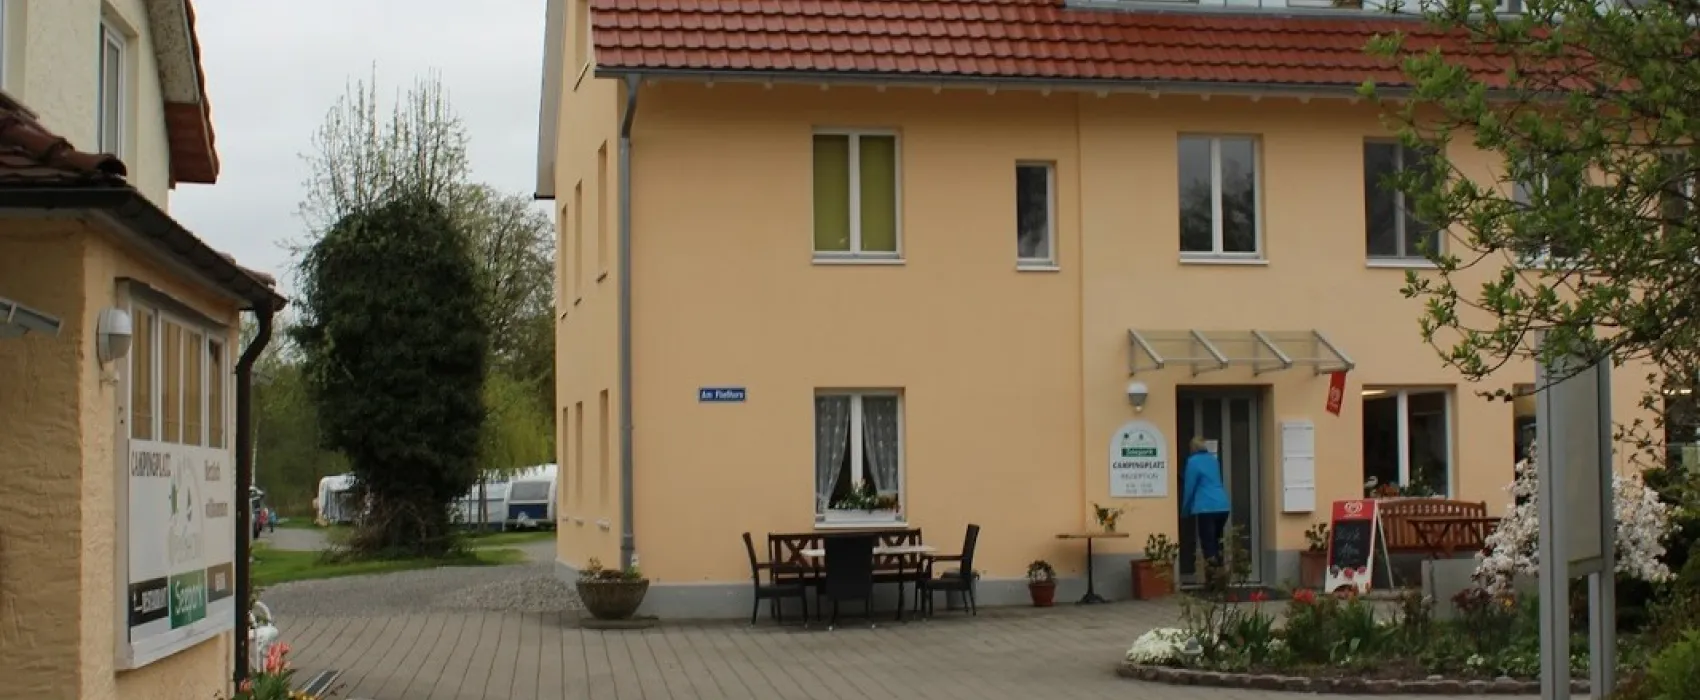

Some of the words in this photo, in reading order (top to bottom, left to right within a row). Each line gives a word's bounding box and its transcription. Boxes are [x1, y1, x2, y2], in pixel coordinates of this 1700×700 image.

[702, 390, 713, 399] Am
[131, 451, 171, 477] CAMPINGPLATZ
[1113, 461, 1165, 469] CAMPINGPLATZ
[175, 577, 203, 620] Seepark
